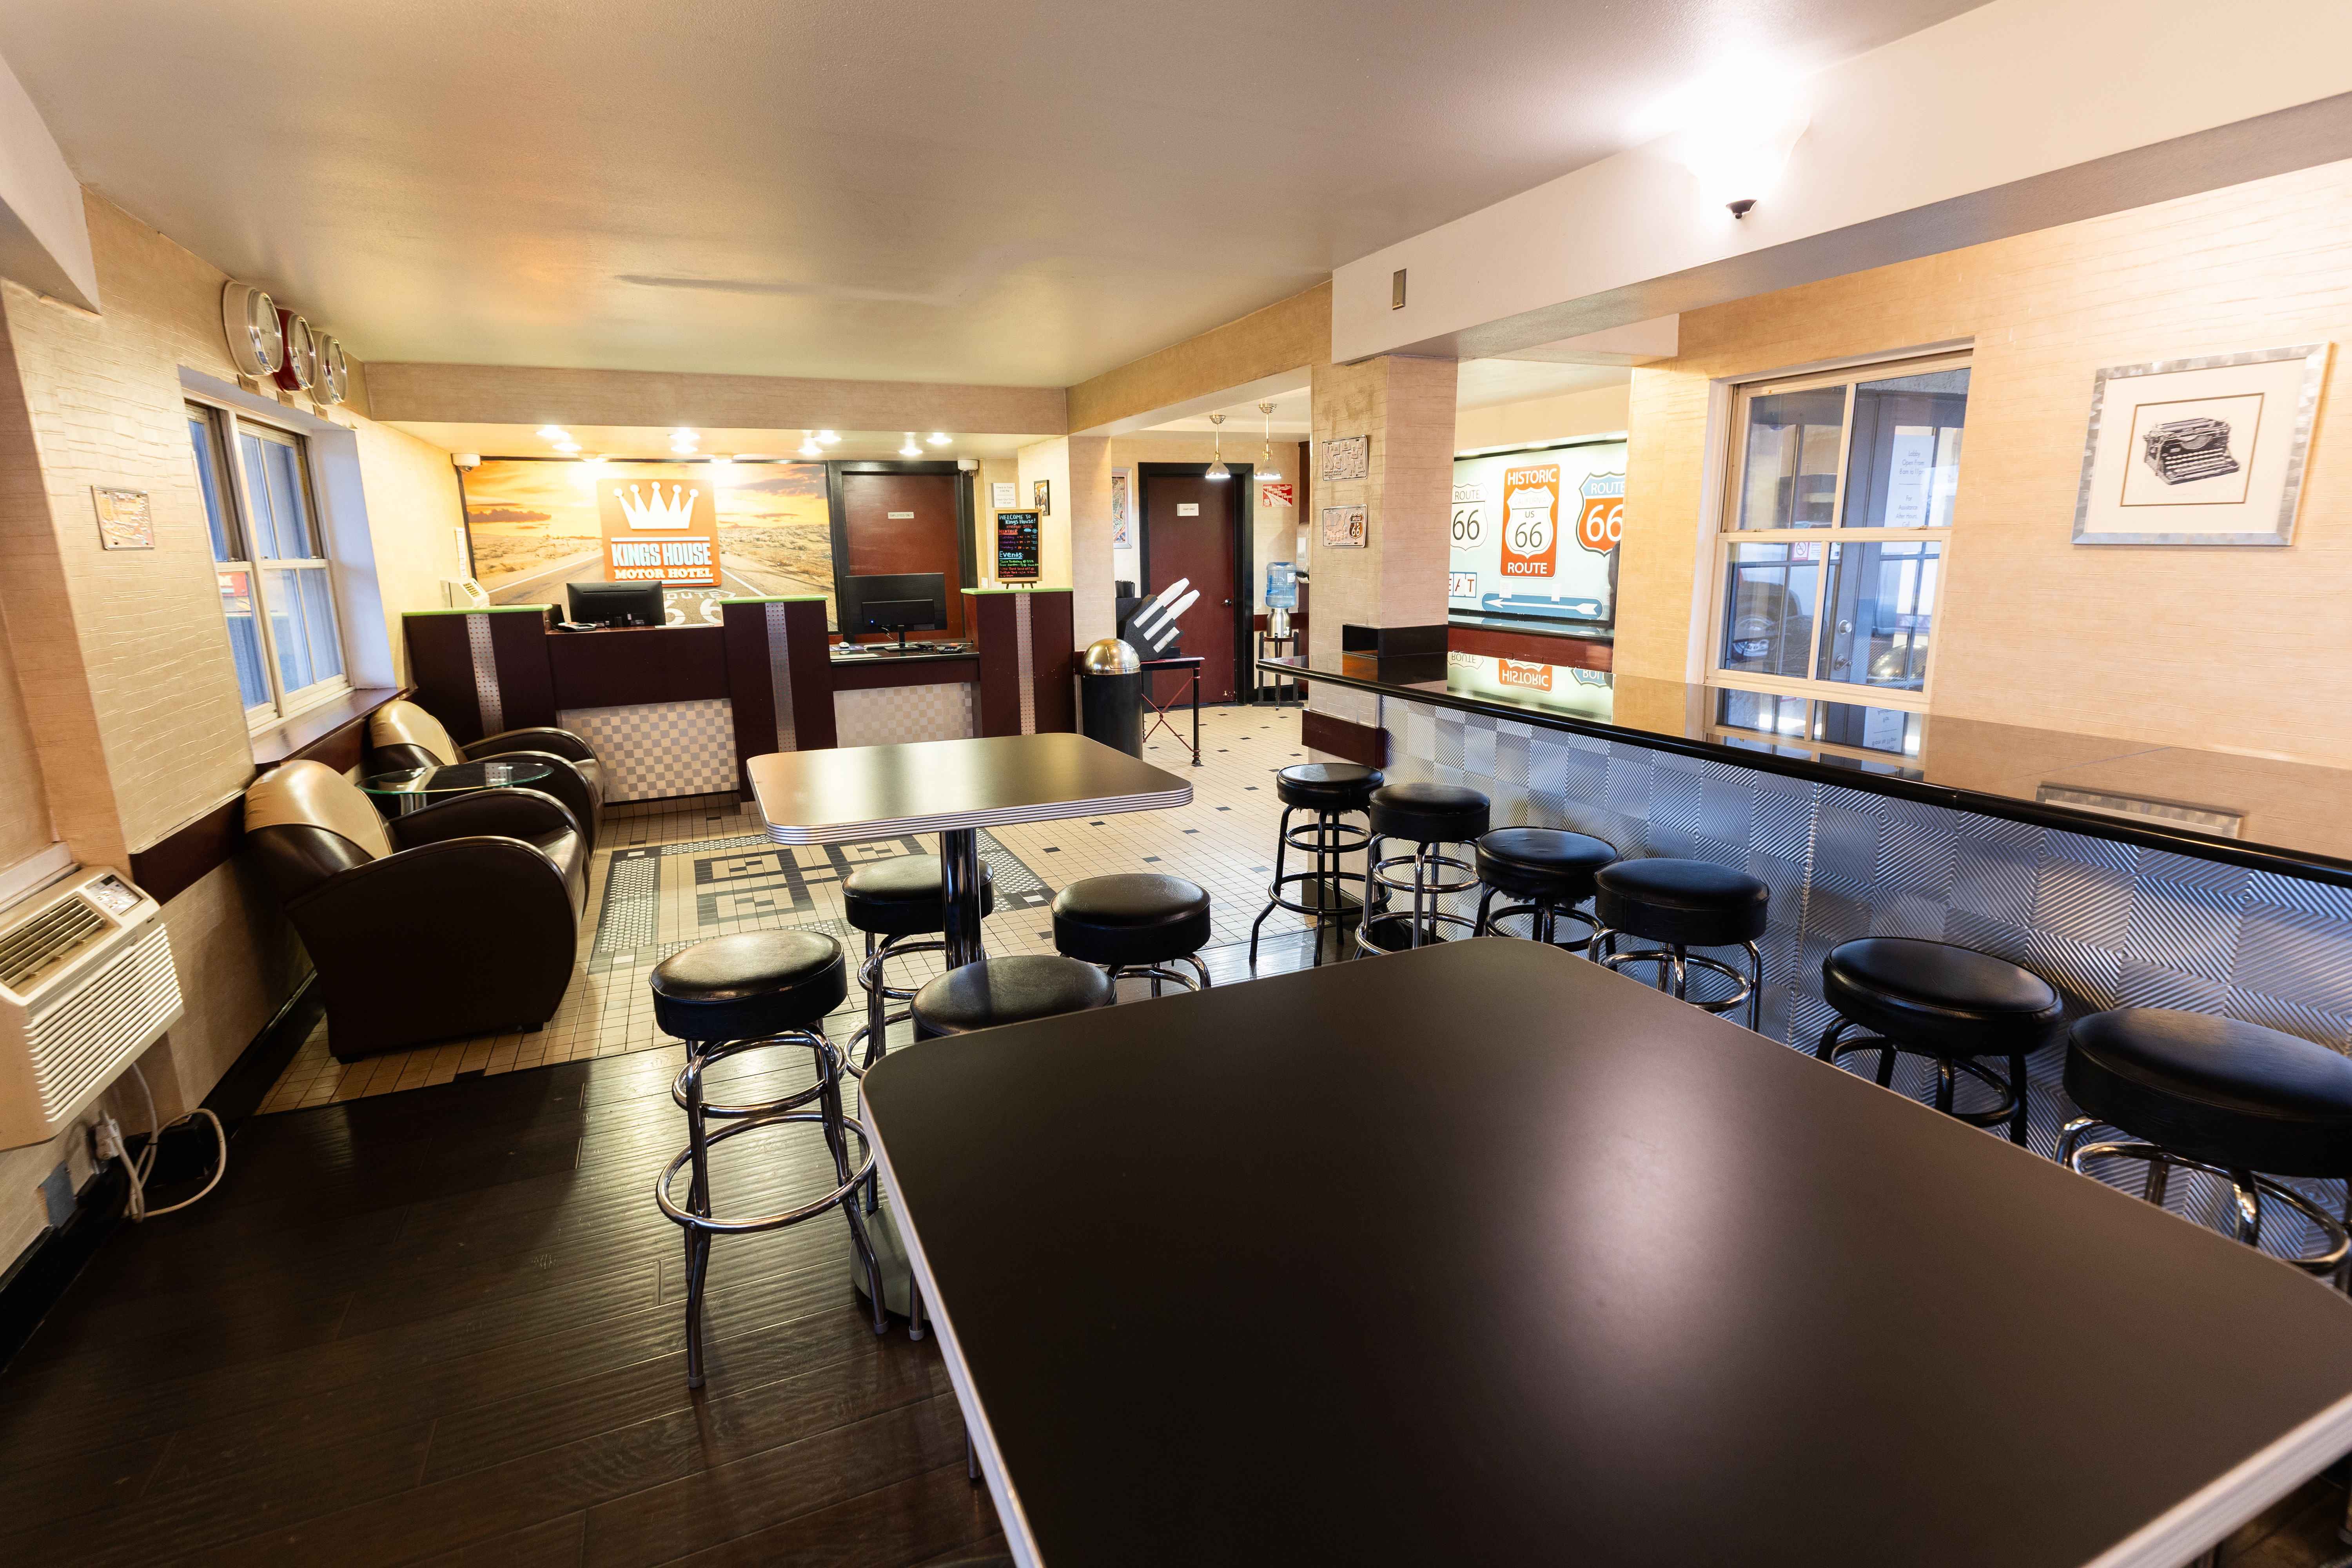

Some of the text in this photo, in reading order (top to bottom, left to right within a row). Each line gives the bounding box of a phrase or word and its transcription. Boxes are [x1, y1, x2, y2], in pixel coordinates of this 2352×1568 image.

[1508, 468, 1557, 485] HISTORIC
[1591, 481, 1625, 494] ROUTE
[1455, 490, 1480, 500] ROUTE
[1514, 497, 1546, 506] CALIFORNIA
[1453, 509, 1479, 540] 66
[1586, 504, 1623, 541] 66
[1352, 526, 1360, 536] 66
[1515, 522, 1543, 548] 66
[611, 543, 712, 566] KINGS HOUSE
[614, 568, 713, 579] MOTOR HOTEL
[1508, 562, 1547, 574] ROUTE
[666, 592, 722, 600] OUTE
